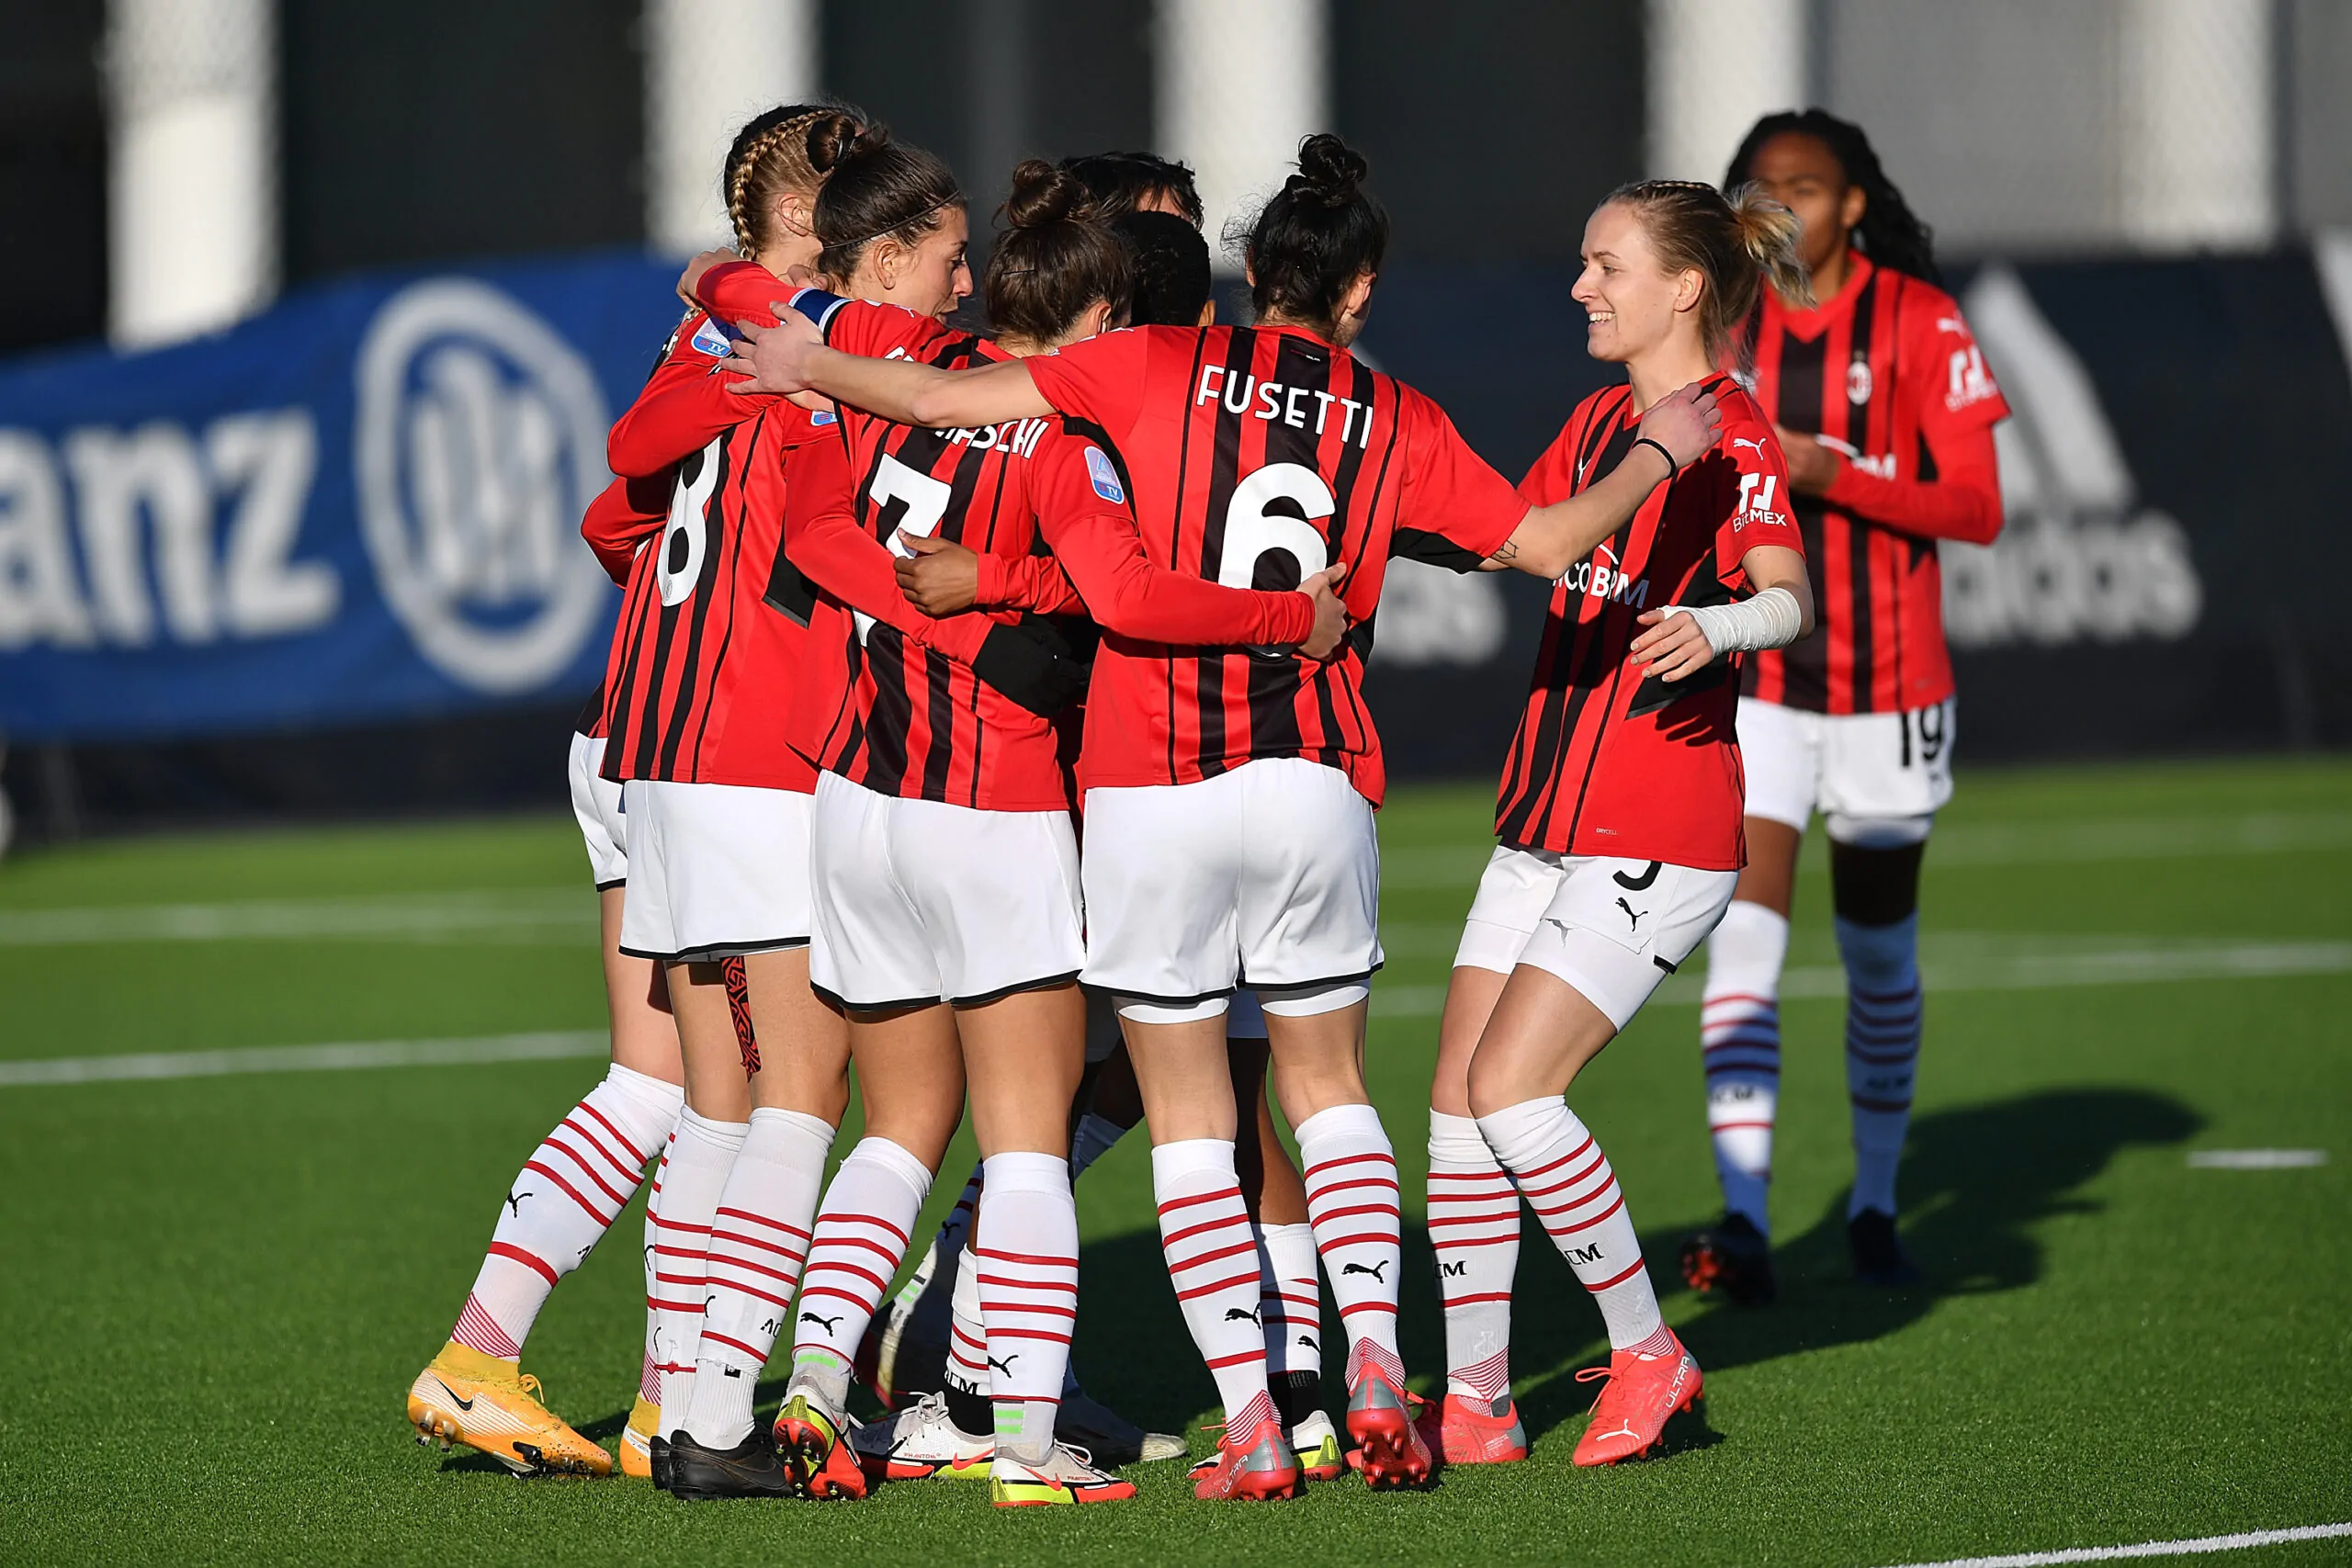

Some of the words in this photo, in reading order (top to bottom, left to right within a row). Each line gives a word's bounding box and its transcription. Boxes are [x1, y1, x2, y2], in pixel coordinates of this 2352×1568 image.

[1196, 364, 1374, 449] FUSETTI
[934, 417, 1049, 459] ASCHI
[656, 434, 720, 607] 8
[1733, 508, 1787, 533] BitMEX
[1218, 462, 1335, 658] 6
[1899, 702, 1943, 768] 19
[1666, 1356, 1690, 1407] ULTRA
[1221, 1454, 1249, 1493] ULTRA
